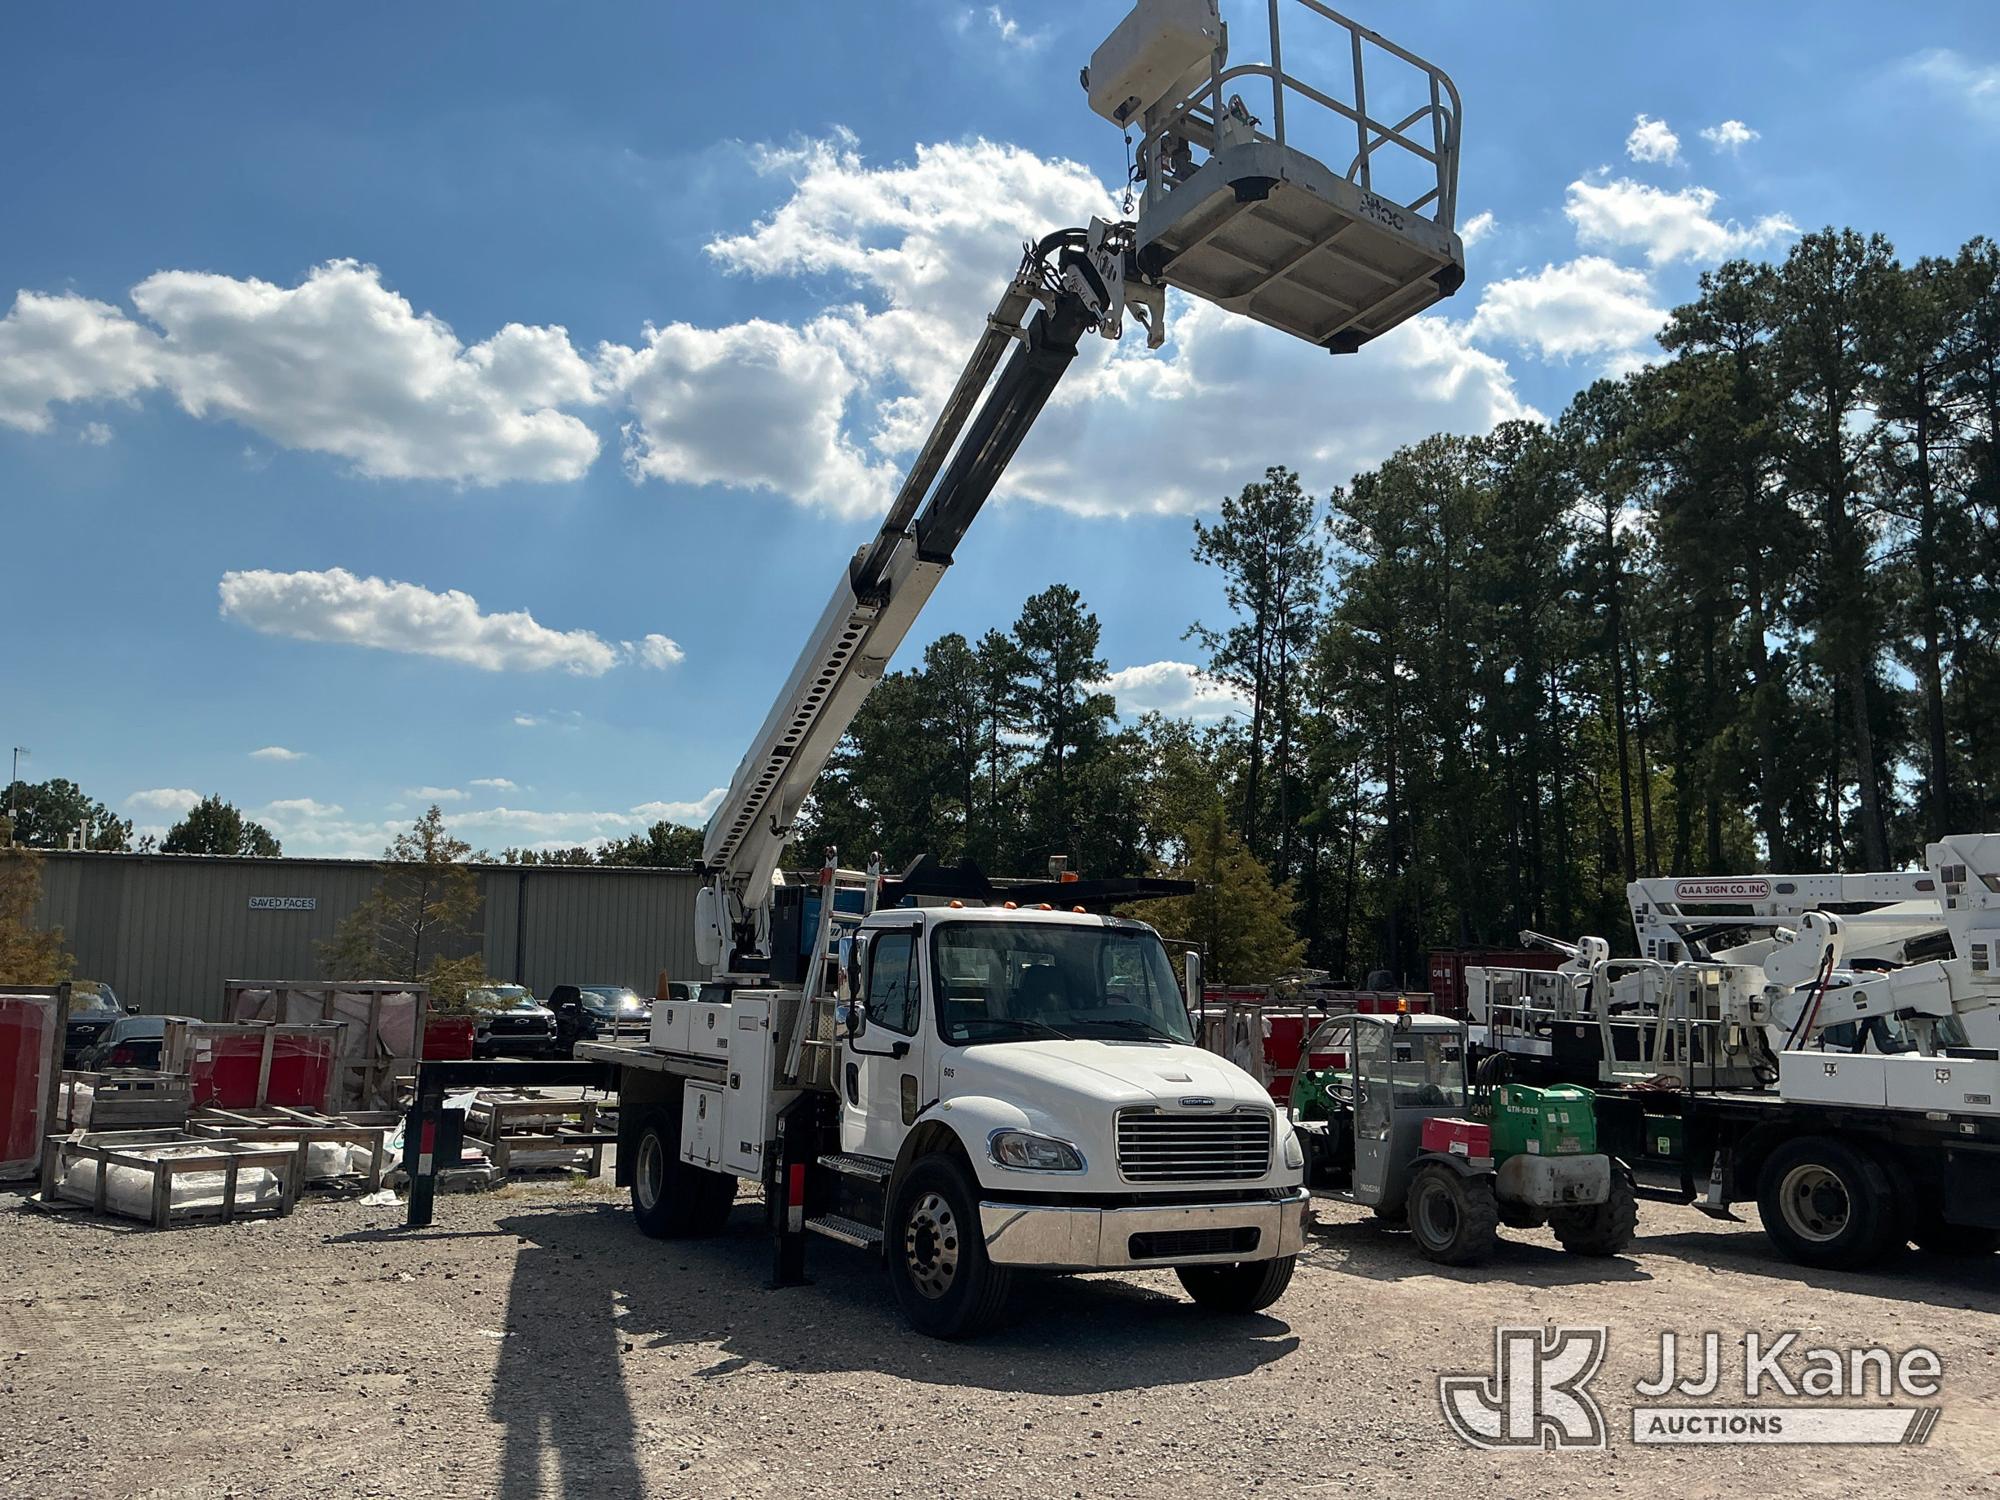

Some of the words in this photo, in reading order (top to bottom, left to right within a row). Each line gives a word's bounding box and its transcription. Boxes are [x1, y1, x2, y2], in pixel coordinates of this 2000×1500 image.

[1680, 886, 1702, 895] AAA
[1705, 885, 1728, 894] SIGN
[1730, 884, 1747, 894] CO.
[251, 898, 282, 907] SAVED
[284, 899, 315, 907] FACES
[943, 1067, 955, 1078] 605
[1506, 1105, 1539, 1115] GTH-5519
